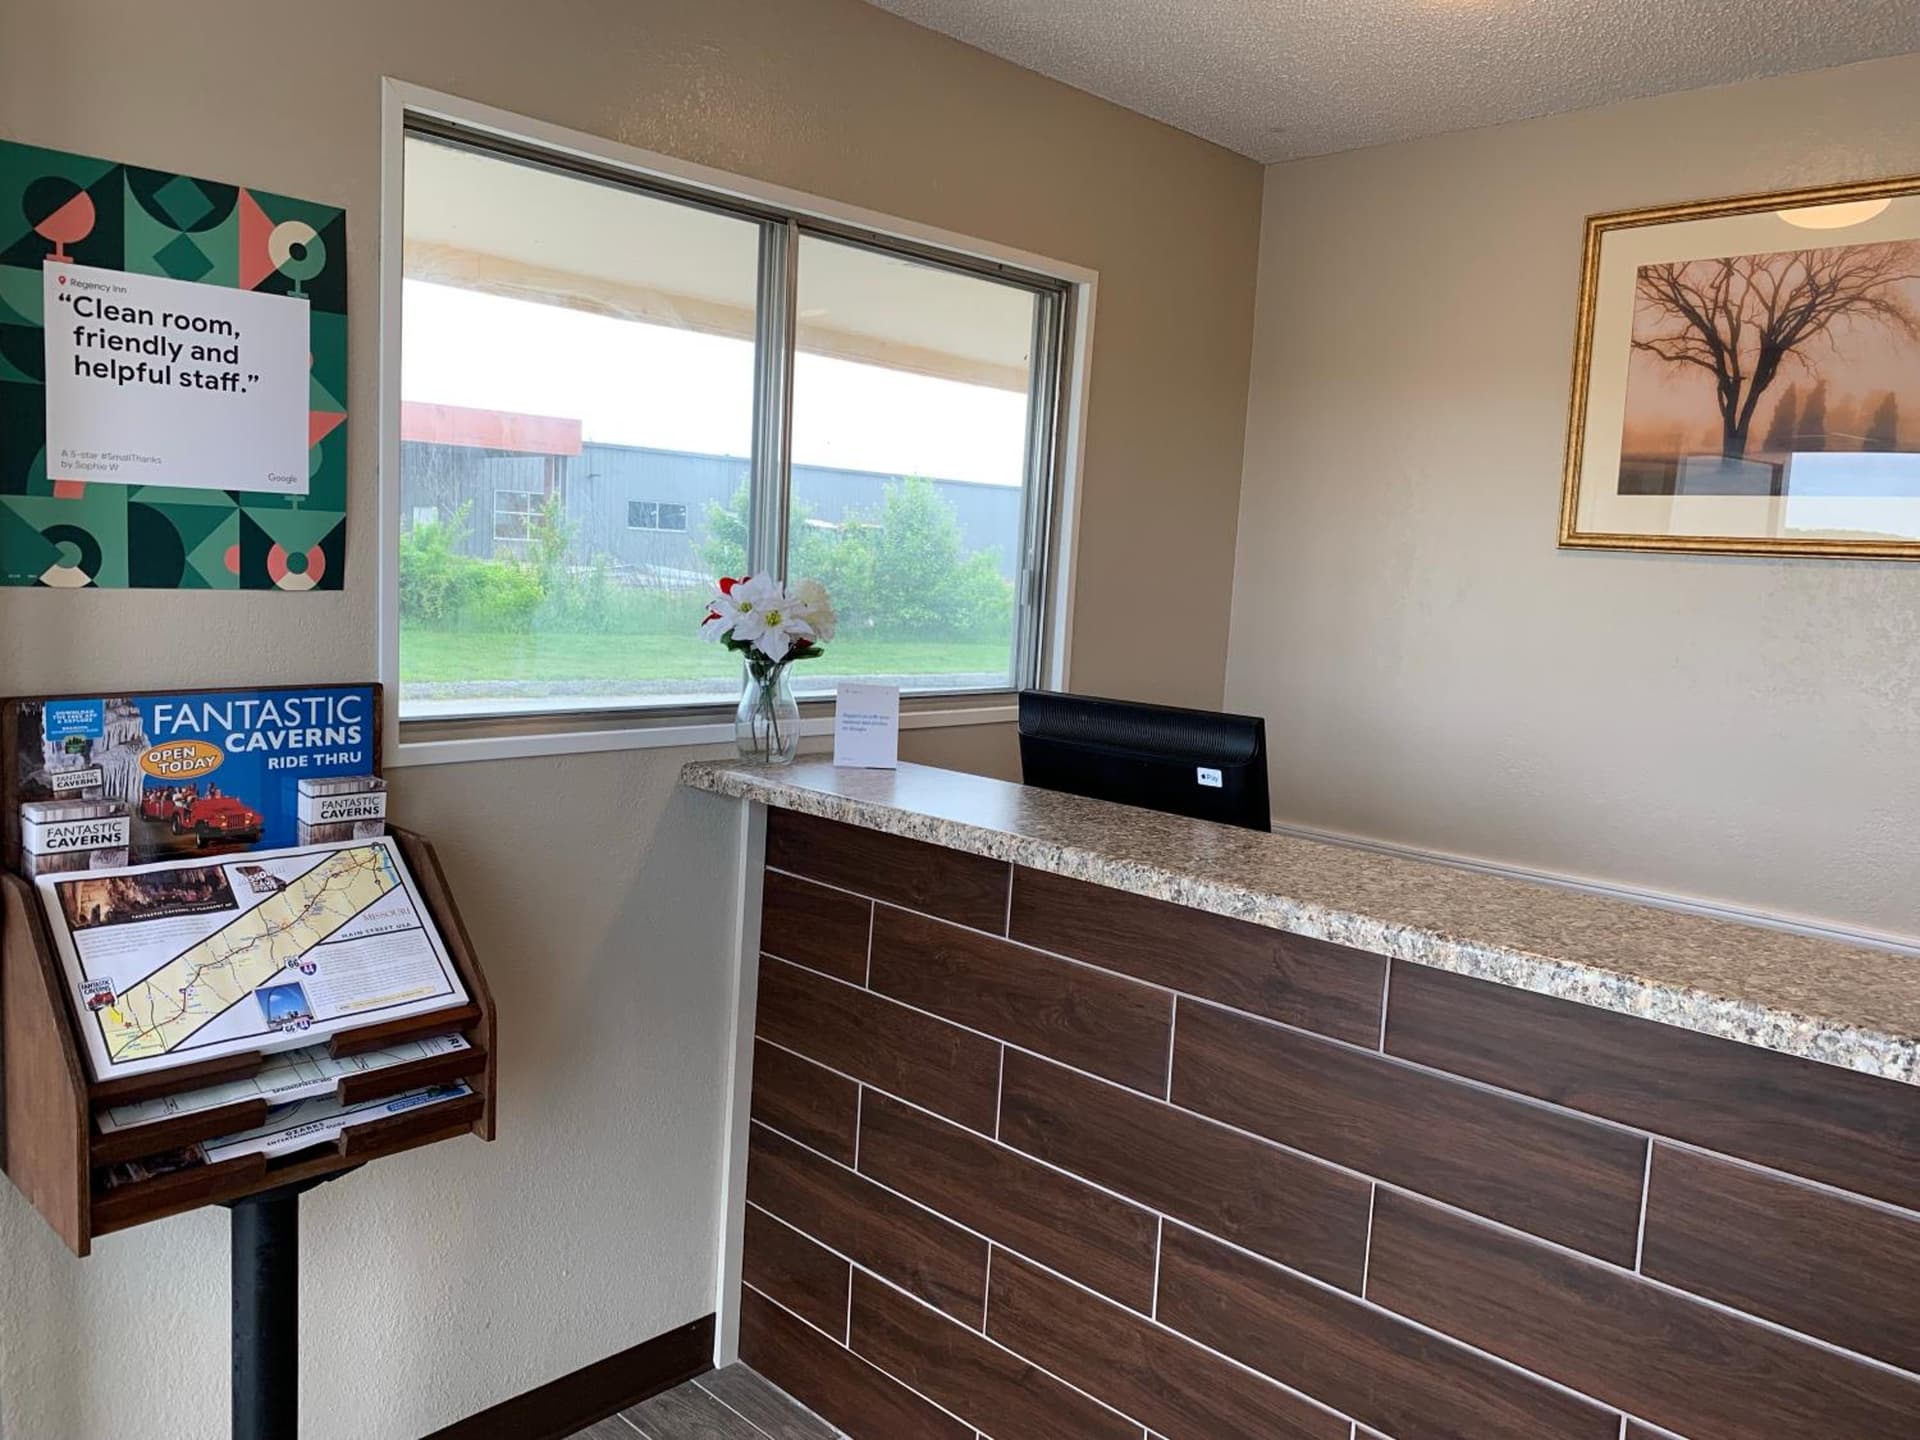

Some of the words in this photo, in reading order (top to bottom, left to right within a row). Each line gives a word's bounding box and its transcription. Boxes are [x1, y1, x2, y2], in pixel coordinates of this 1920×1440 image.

[70, 278, 111, 293] Regency
[112, 284, 128, 294] Inn
[162, 312, 241, 339] room,
[73, 326, 183, 363] friendly
[190, 345, 239, 365] and
[74, 355, 171, 386] helpful
[60, 460, 73, 470] by
[109, 463, 119, 472] W
[101, 452, 162, 465] #SmallThanks
[267, 472, 298, 483] Google
[154, 695, 362, 735] FANTASTIC
[225, 726, 362, 752] CAVERNS
[149, 747, 196, 763] OPEN
[267, 755, 308, 770] RIDE
[313, 751, 362, 767] THRU
[158, 755, 217, 775] TODAY
[56, 771, 97, 781] FANTASTIC
[56, 778, 98, 788] CAVERNS
[321, 796, 380, 810] FANTASTIC
[320, 806, 380, 820] CAVERNS
[46, 822, 122, 838] FANTASTIC
[46, 832, 122, 849] CAVERNS
[362, 907, 411, 921] MISSOURI
[341, 930, 363, 939] MAIN
[365, 924, 393, 934] STREET
[287, 958, 300, 969] 66
[266, 1127, 325, 1147] ENTERTAINMENT
[285, 1122, 325, 1136] OZARKS
